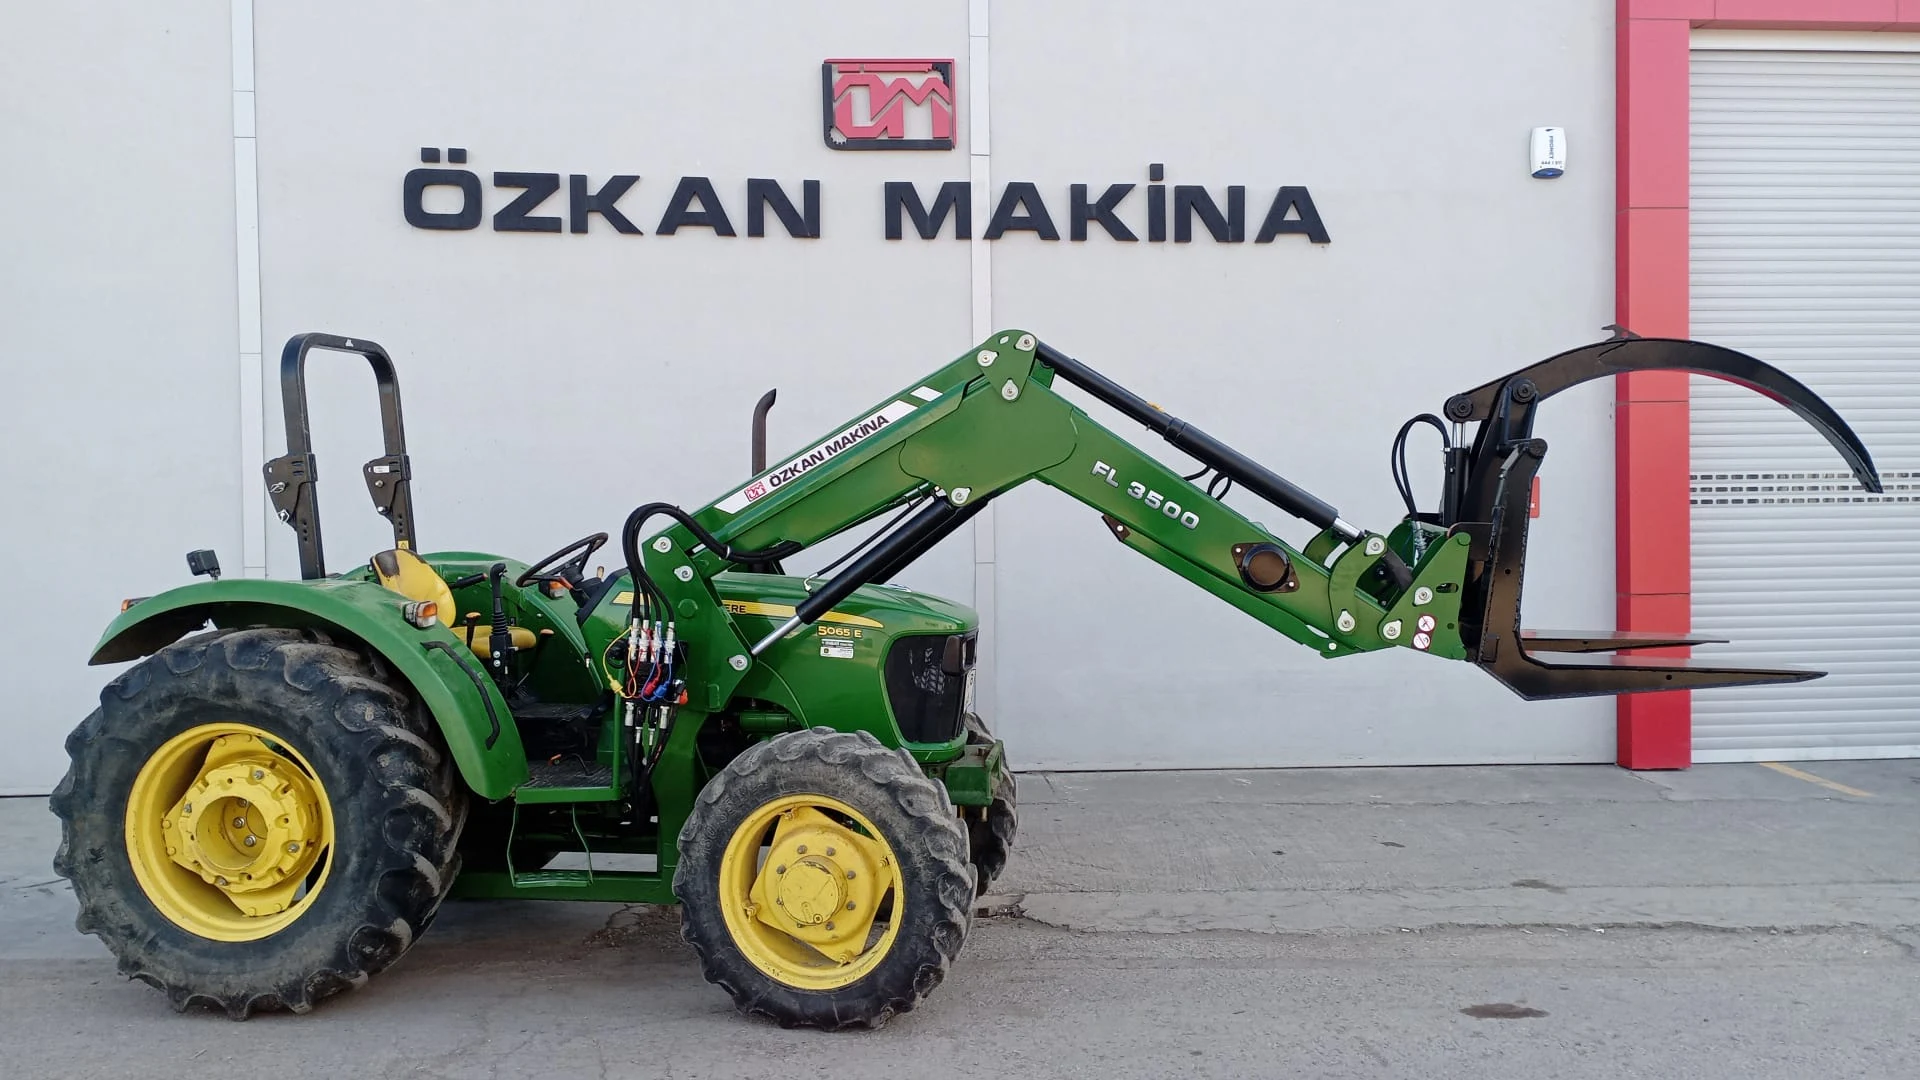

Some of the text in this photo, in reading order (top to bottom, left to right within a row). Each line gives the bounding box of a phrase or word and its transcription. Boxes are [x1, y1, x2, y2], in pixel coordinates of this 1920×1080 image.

[404, 147, 1332, 244] ÖZKAN MAKİNA
[769, 450, 825, 488] ÖZKAN
[825, 414, 890, 456] MAKİNA
[1091, 460, 1200, 530] FL 3500
[817, 625, 863, 638] 5065 E
